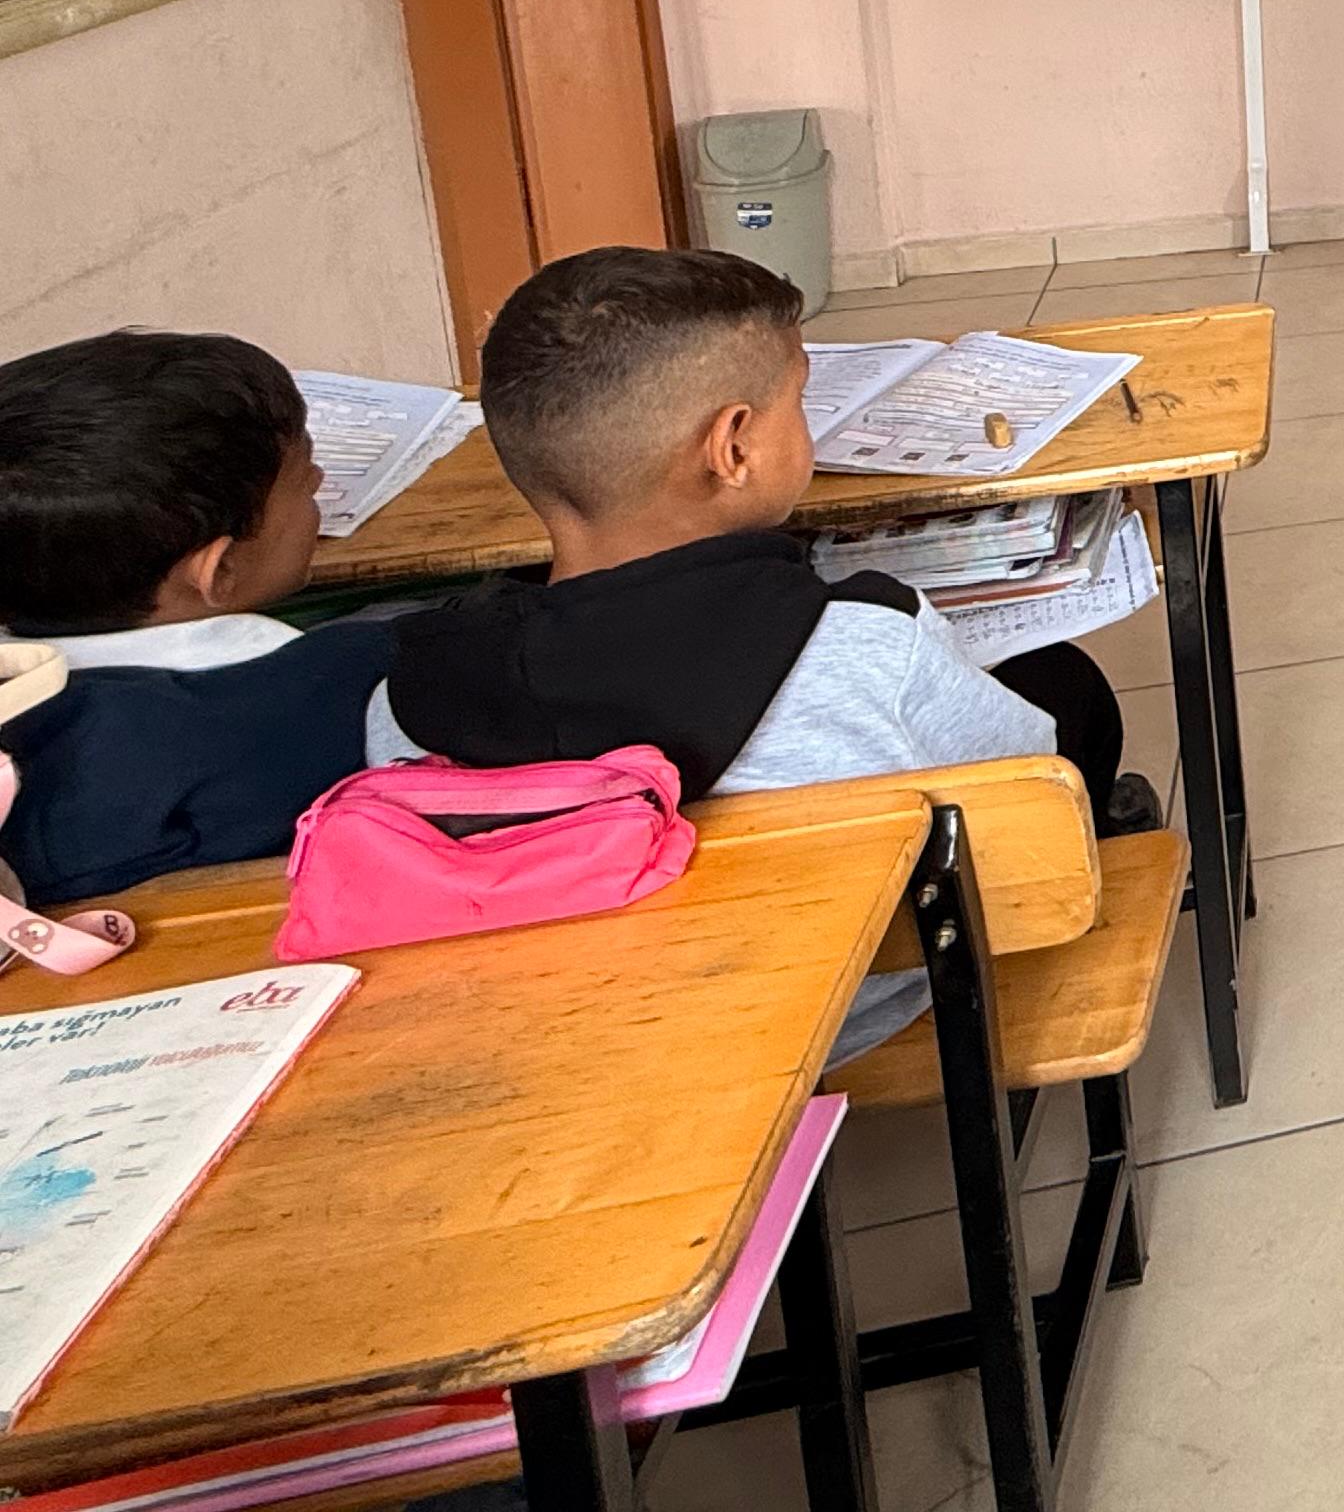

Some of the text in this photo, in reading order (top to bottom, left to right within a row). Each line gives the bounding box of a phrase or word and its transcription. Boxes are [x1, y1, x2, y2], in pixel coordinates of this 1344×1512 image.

[50, 996, 182, 1030] sığmayan
[0, 1021, 105, 1051] ler var!
